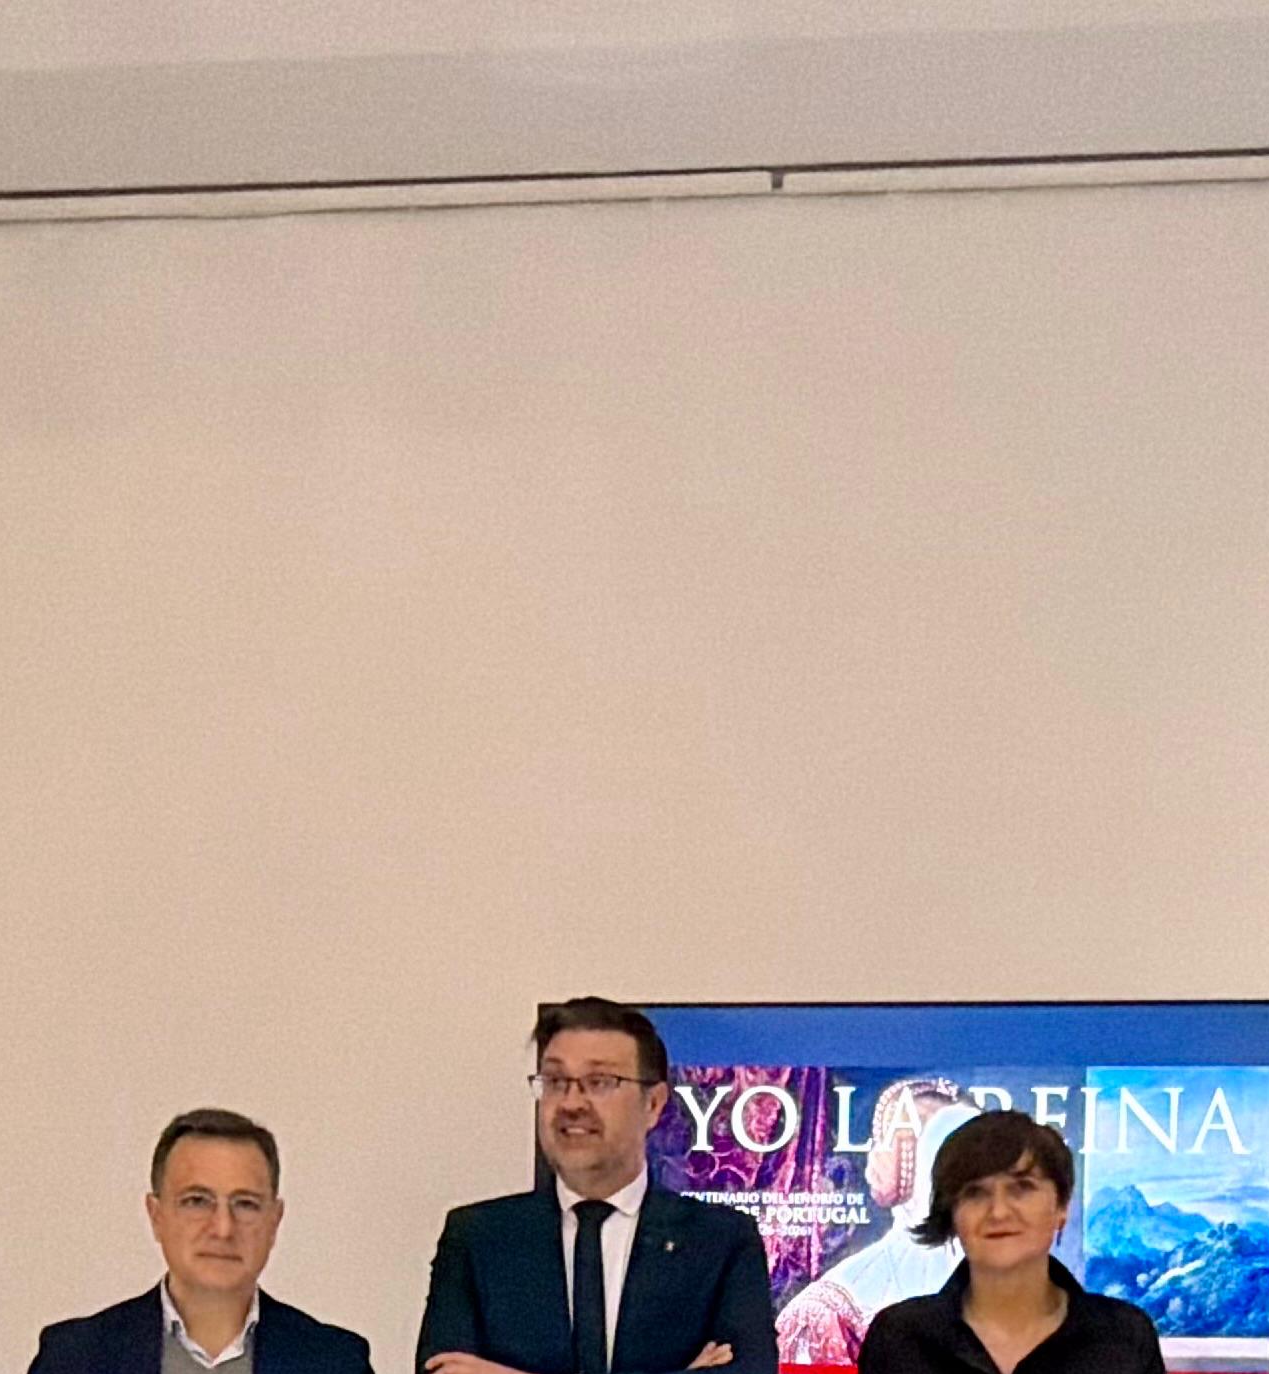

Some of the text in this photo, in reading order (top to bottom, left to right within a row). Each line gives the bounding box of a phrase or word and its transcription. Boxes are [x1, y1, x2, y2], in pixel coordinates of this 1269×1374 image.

[674, 1085, 798, 1153] YO
[833, 1086, 923, 1153] LA
[847, 1193, 864, 1205] DE
[765, 1206, 870, 1224] PORTUGAL
